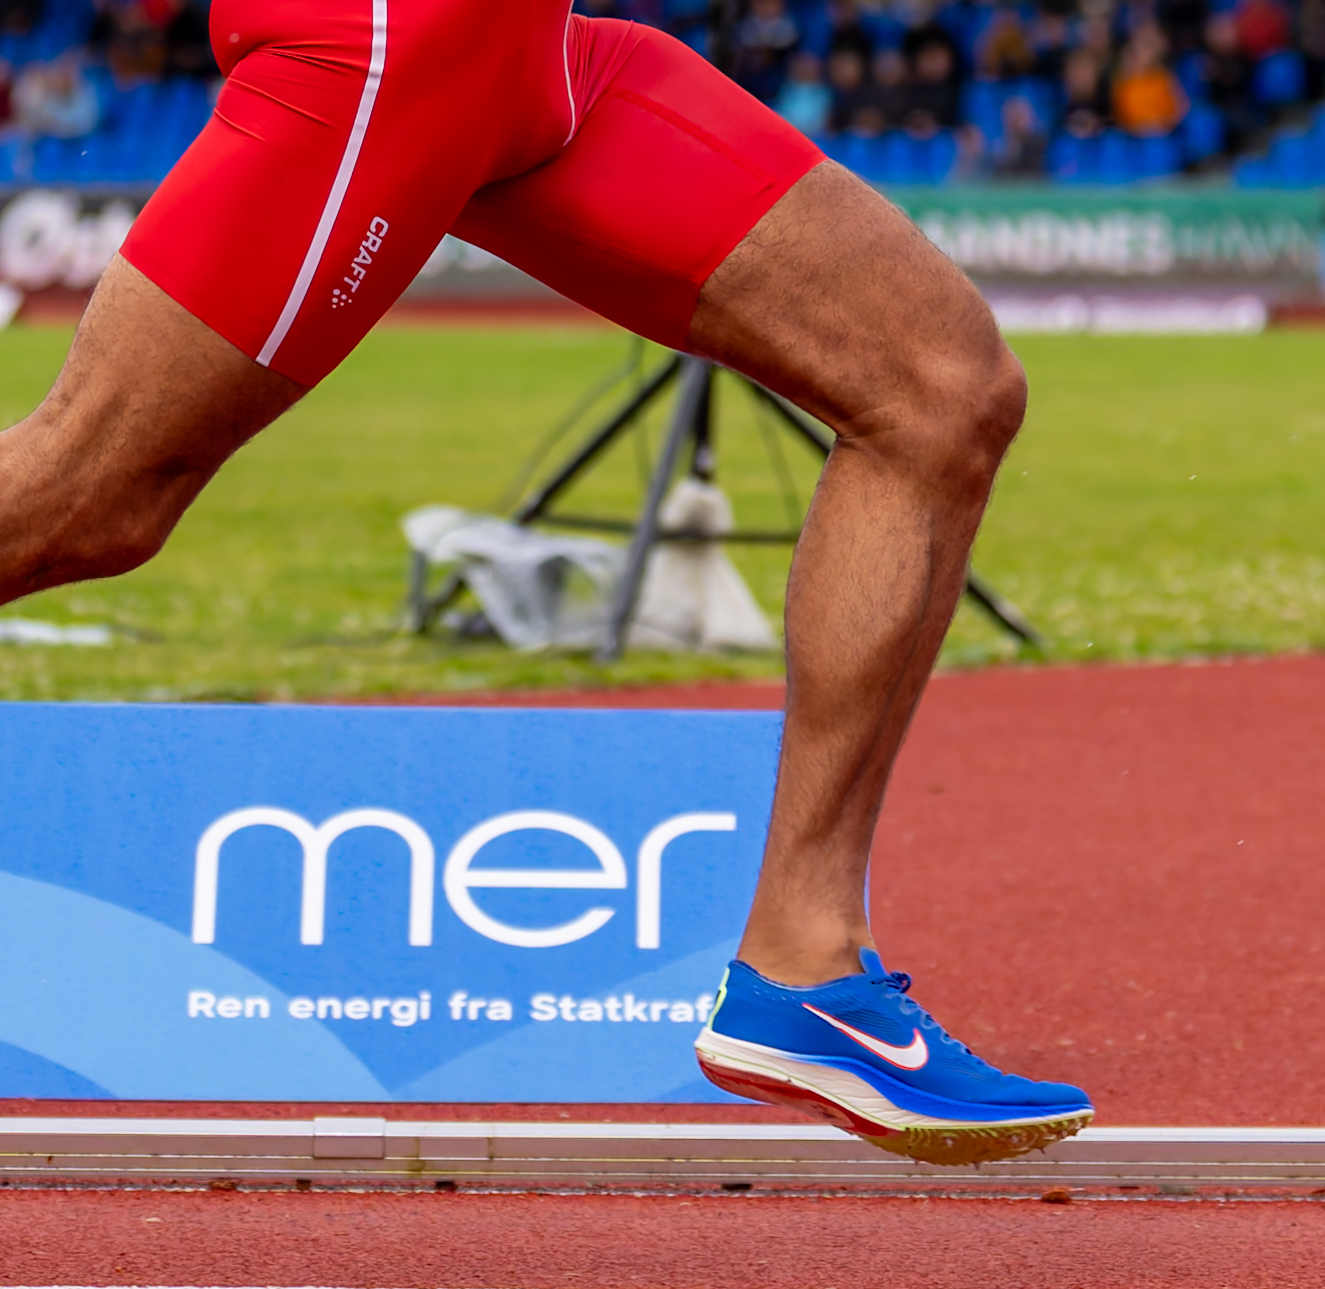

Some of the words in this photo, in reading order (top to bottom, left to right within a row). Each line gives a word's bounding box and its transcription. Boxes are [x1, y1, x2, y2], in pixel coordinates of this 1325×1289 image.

[343, 215, 390, 294] CRAFT
[191, 807, 737, 950] mer
[187, 991, 271, 1020] Ren
[287, 991, 431, 1028] energi
[448, 992, 513, 1022] fra
[530, 992, 715, 1024] Statkraf
